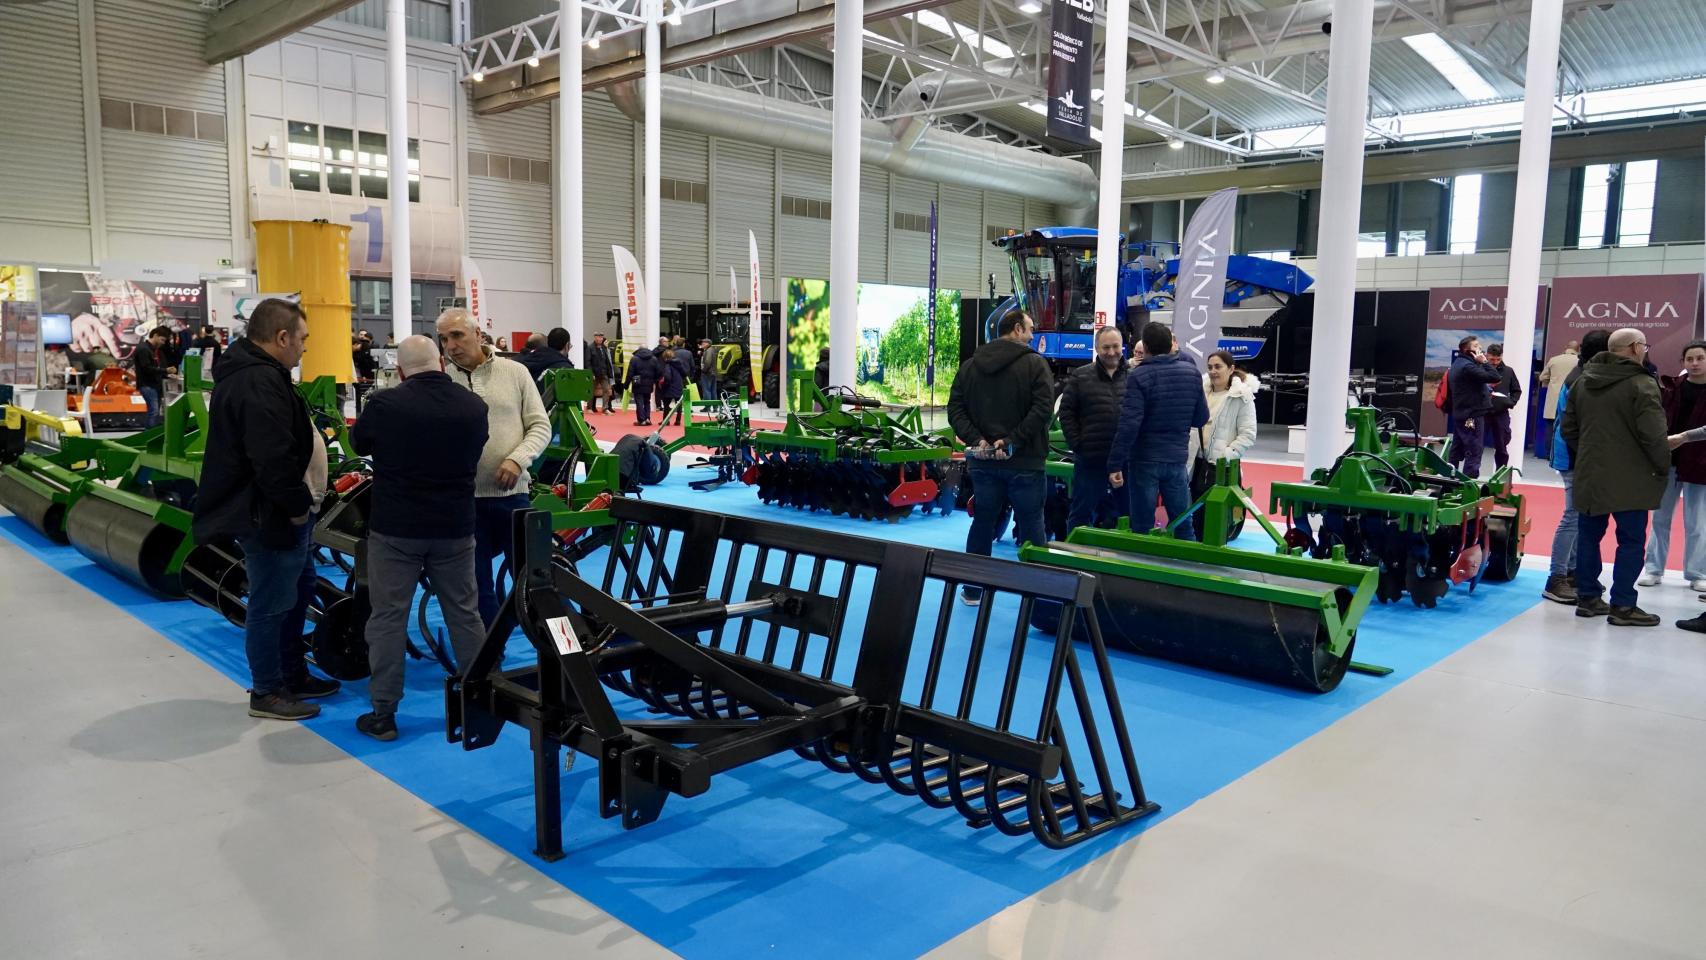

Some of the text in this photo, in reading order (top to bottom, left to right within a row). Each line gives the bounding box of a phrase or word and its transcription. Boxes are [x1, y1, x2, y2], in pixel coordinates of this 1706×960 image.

[351, 206, 383, 263] 1
[154, 286, 200, 296] INFACO
[1185, 228, 1218, 358] AGNIA
[1439, 297, 1508, 312] AGNI
[1563, 301, 1680, 319] AGNIA
